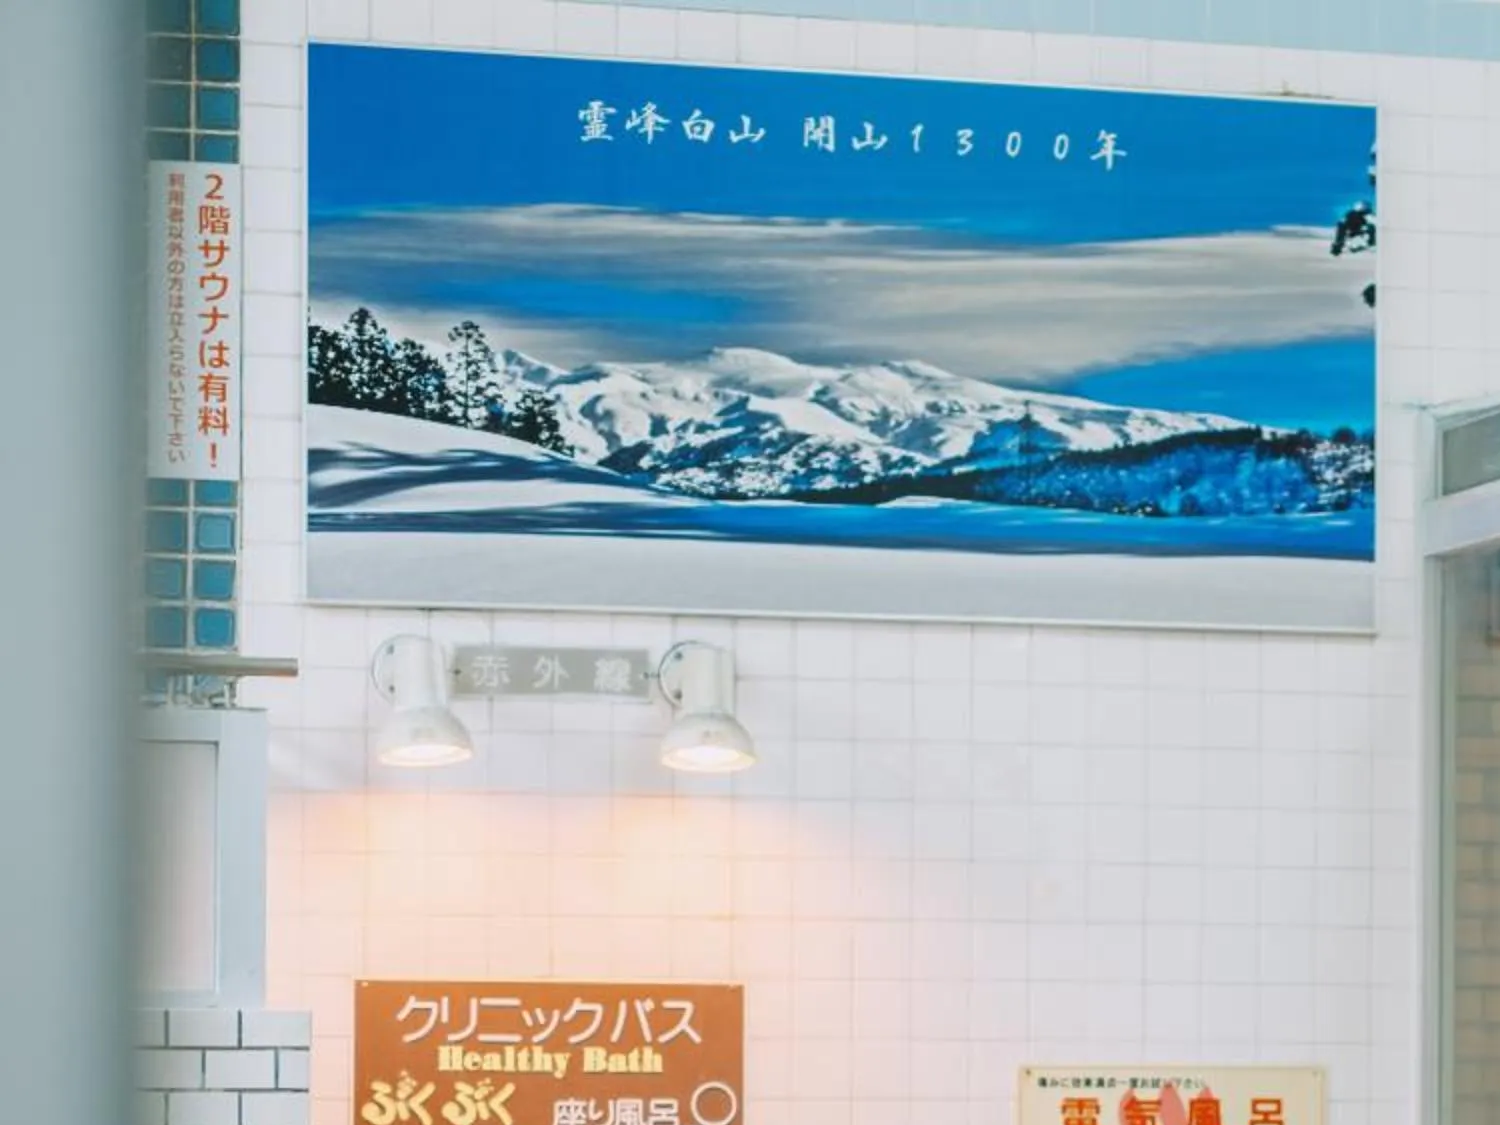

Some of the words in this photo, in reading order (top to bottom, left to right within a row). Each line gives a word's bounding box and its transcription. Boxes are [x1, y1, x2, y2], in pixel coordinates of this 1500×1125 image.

[578, 100, 766, 145] 霊峰白山
[470, 655, 632, 691] 赤外線
[396, 995, 703, 1044] クリニックバス
[438, 1046, 571, 1078] Healthy
[583, 1047, 664, 1074] Bath
